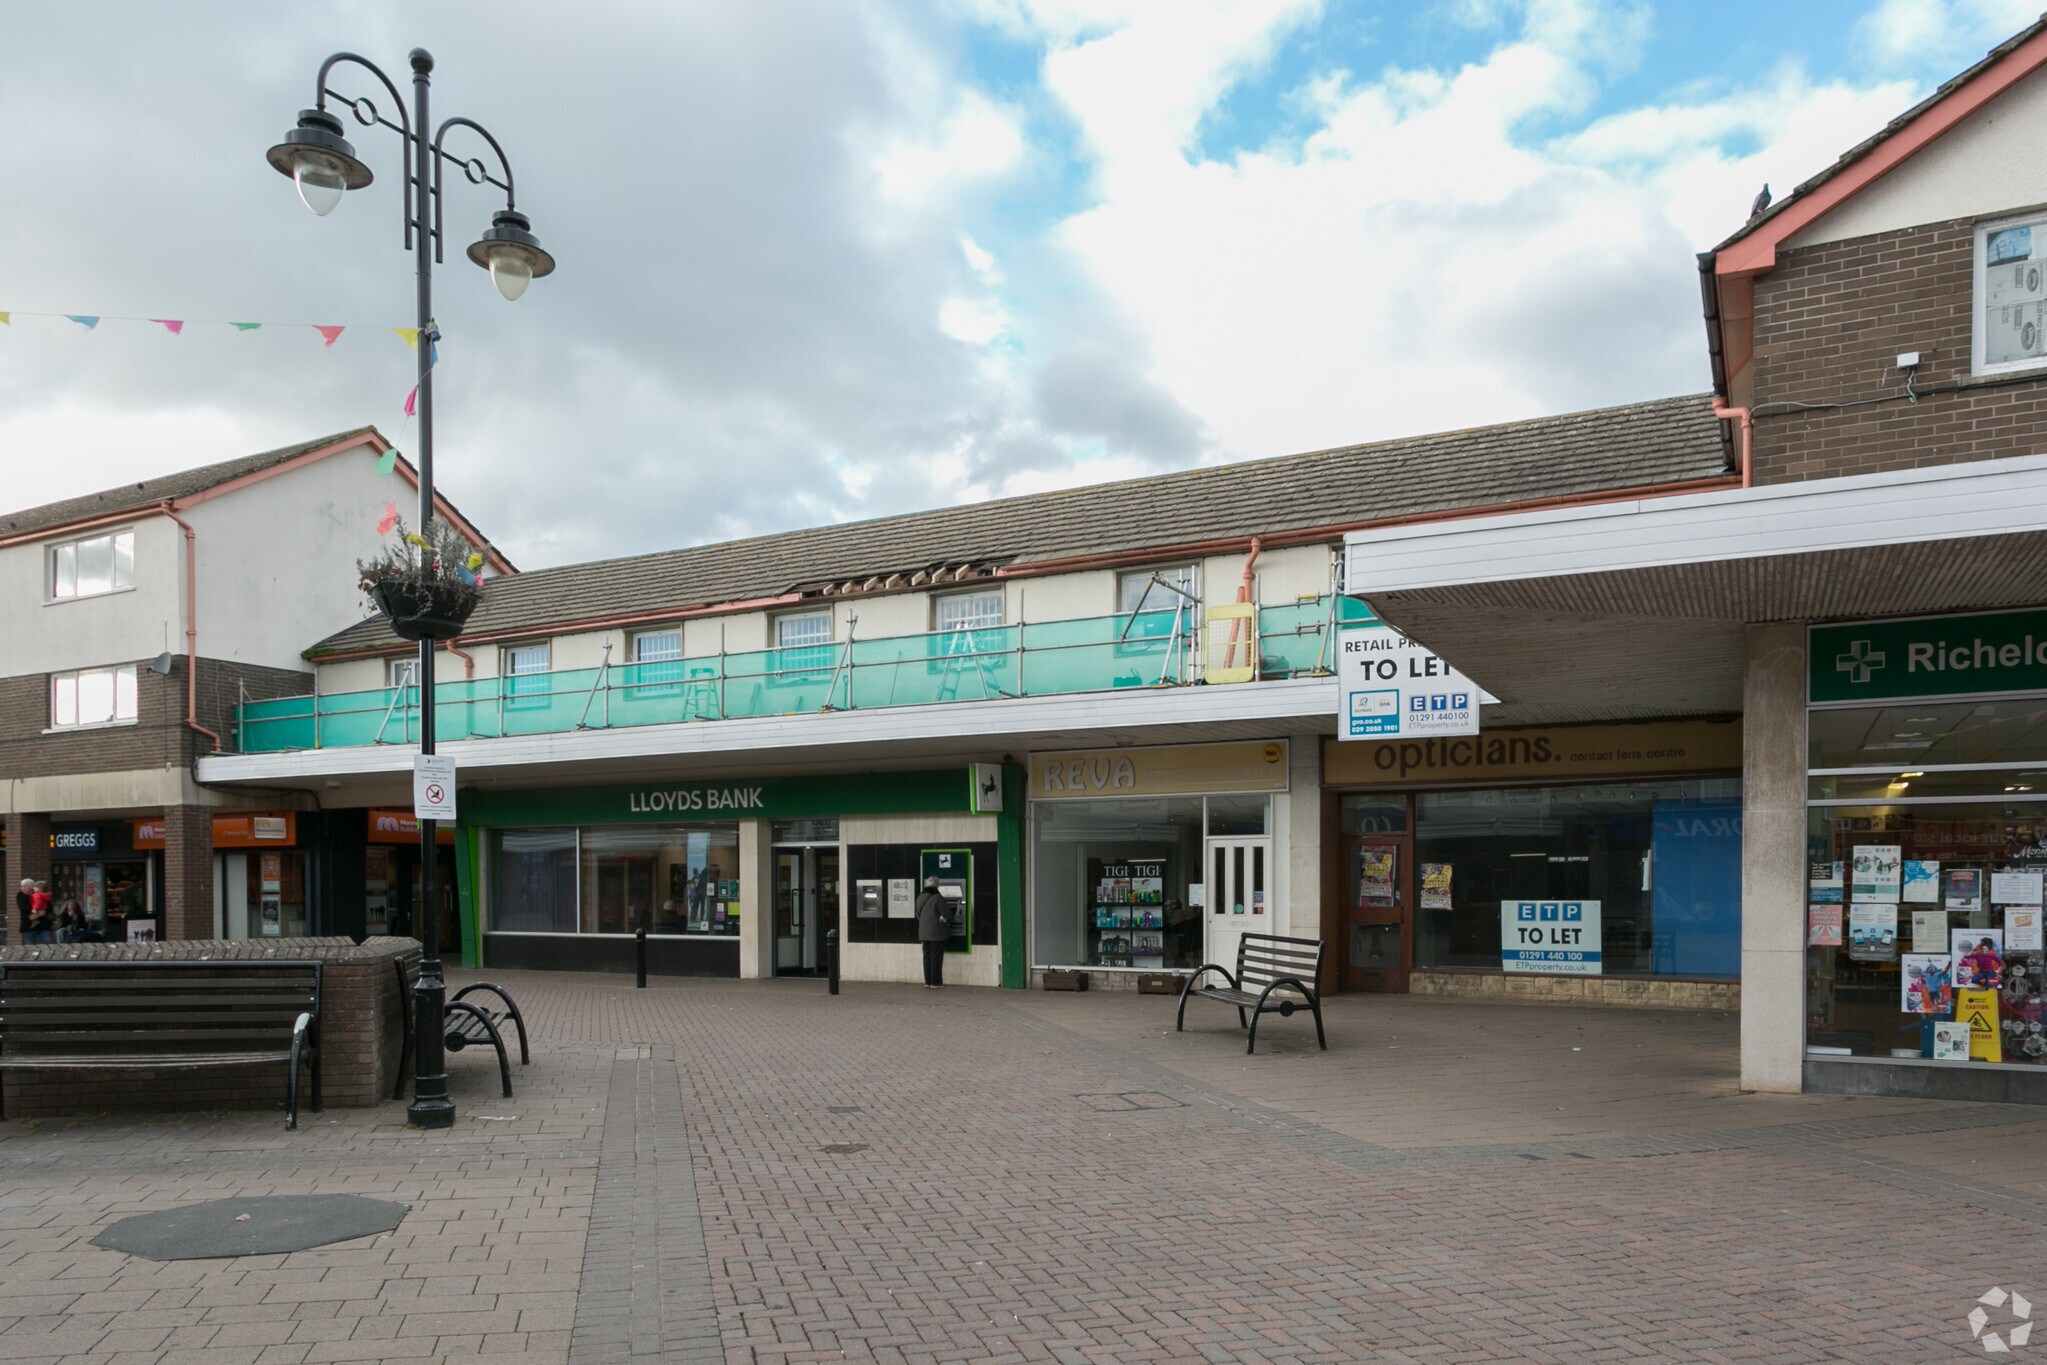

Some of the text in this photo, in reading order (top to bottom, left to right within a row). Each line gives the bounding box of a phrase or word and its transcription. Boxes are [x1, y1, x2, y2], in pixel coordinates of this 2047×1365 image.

[1345, 638, 1393, 653] RETAIL
[1360, 659, 1398, 681] TO
[1351, 718, 1382, 726] gva.co.uk
[1409, 711, 1469, 722] 01291 440100
[1408, 721, 1469, 731] ETPproperty.co.uk
[1569, 747, 1686, 763] contact lens centre
[1043, 756, 1136, 791] REVA
[630, 787, 764, 812] LLOYDS BANK
[55, 832, 97, 848] GREGGS
[1103, 865, 1160, 877] TIGI TIGI
[1517, 927, 1582, 945] TO LET
[1519, 951, 1583, 961] 01291 440 100
[1515, 961, 1588, 973] ETPproperty.co.uk
[1965, 1003, 1990, 1011] CAUTION
